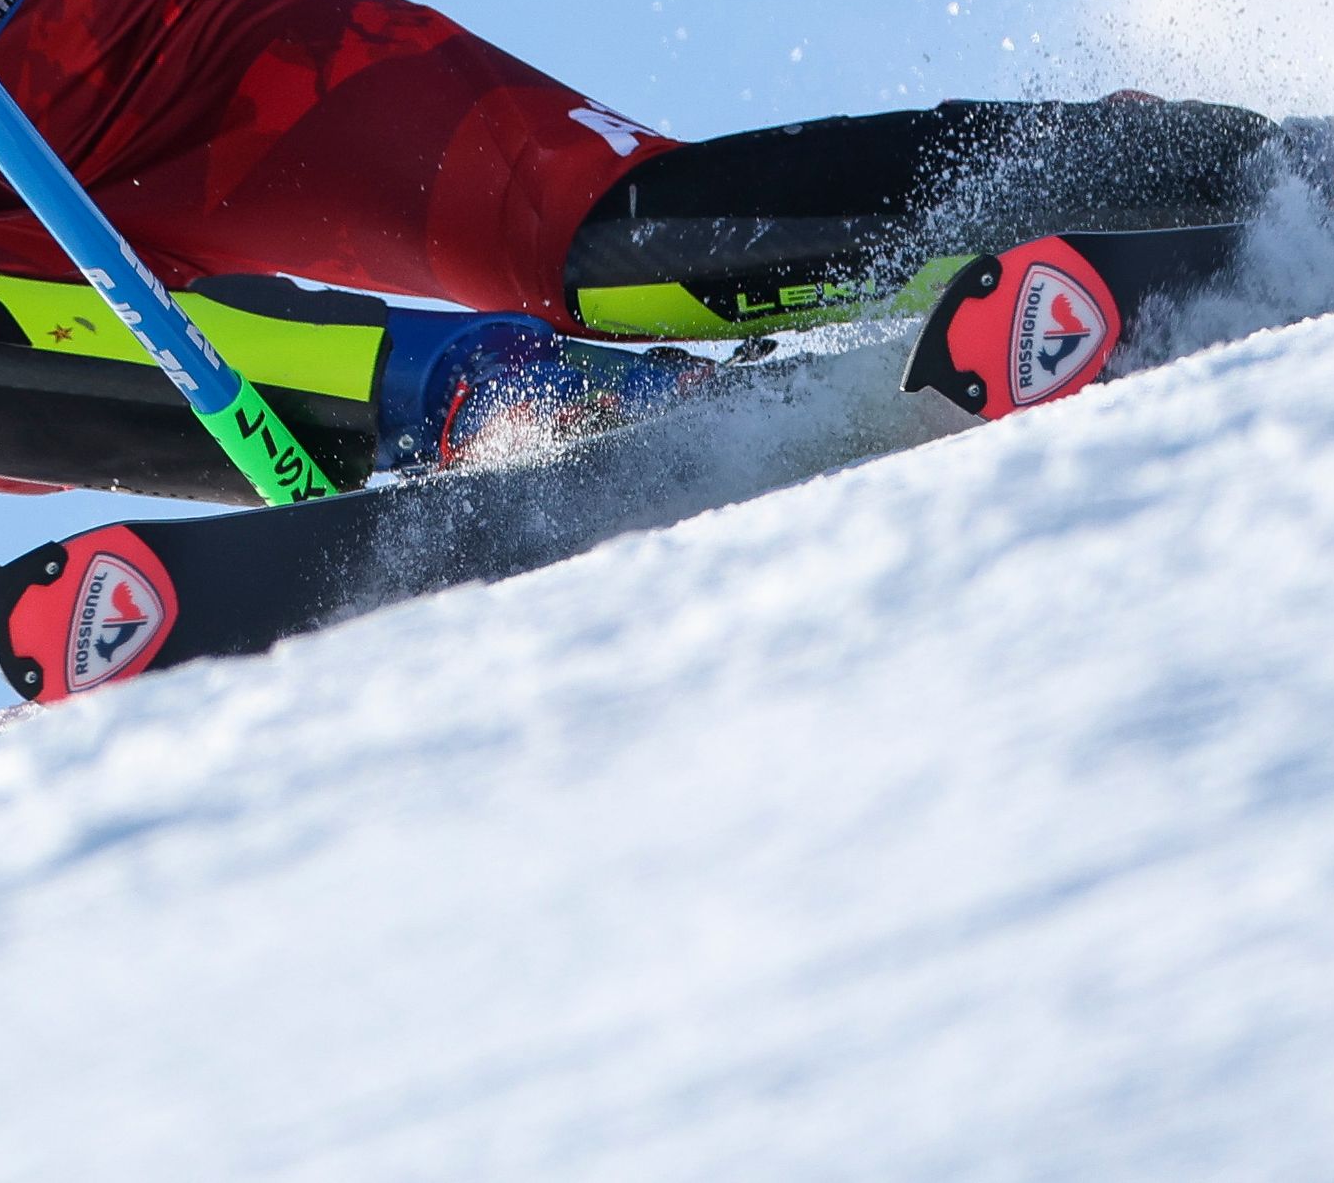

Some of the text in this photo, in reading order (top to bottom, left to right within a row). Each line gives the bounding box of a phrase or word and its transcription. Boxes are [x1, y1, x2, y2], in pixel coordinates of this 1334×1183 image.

[1018, 281, 1045, 389] ROSSIGNOL
[235, 407, 326, 503] LISK
[75, 571, 108, 676] ROSSIGNOL
